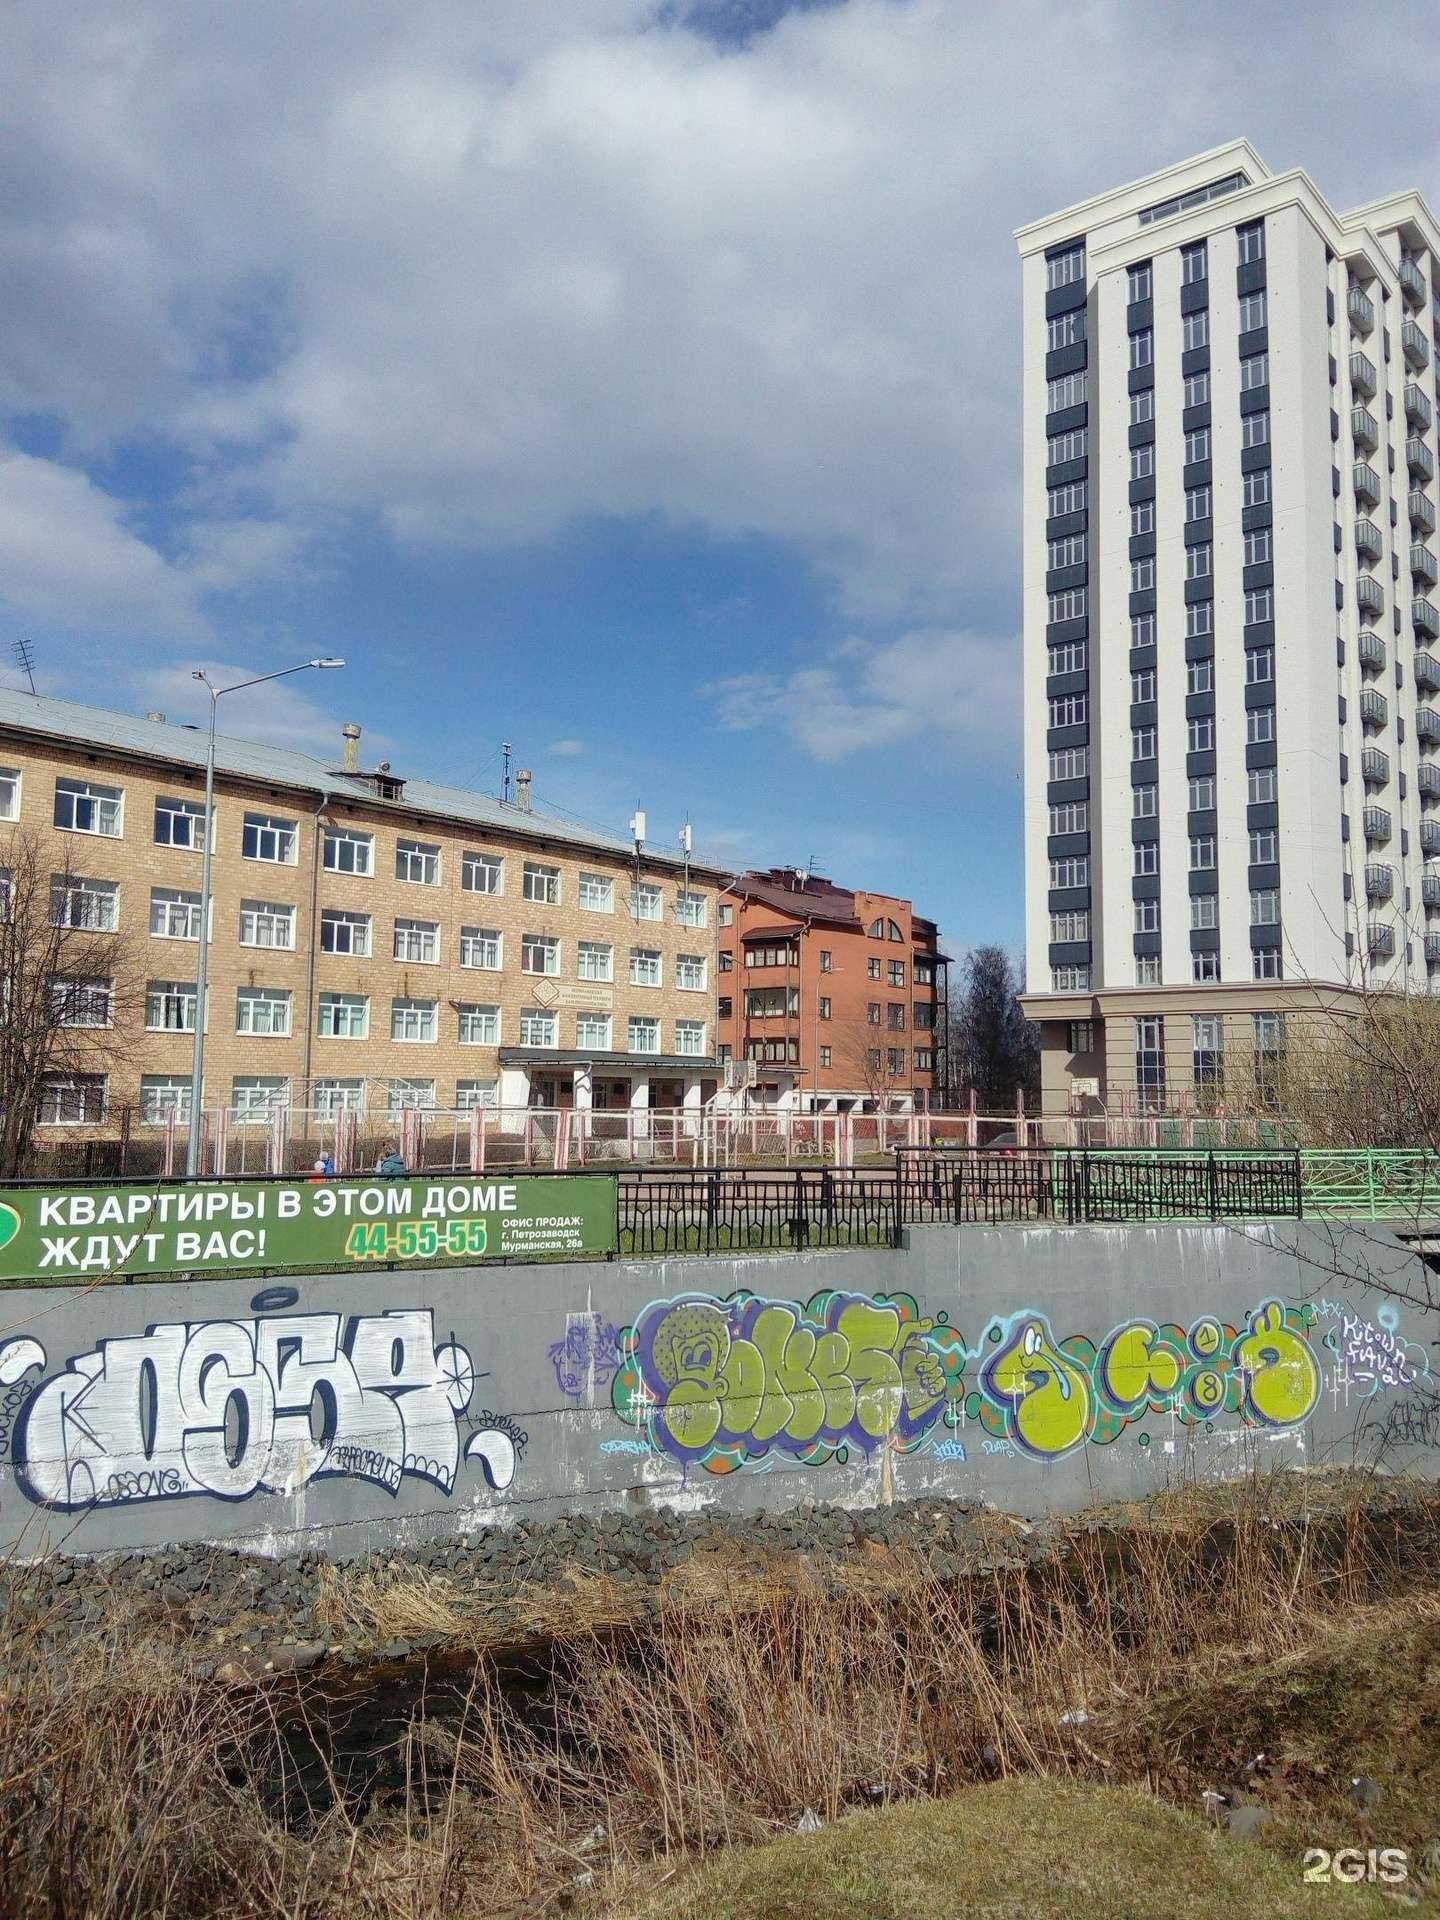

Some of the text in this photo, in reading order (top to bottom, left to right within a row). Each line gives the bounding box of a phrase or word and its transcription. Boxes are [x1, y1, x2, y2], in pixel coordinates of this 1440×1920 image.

[39, 1185, 517, 1227] КВАРТИРЫ В ЭТОМ ДОМЕ
[501, 1229, 580, 1240] г. Петрозаводск
[502, 1216, 584, 1228] ОФИС ПРОДАЖ:
[38, 1229, 266, 1271] ЖДУТ ВАС!
[345, 1218, 487, 1260] 44-55-55
[501, 1241, 564, 1252] Мурманская,
